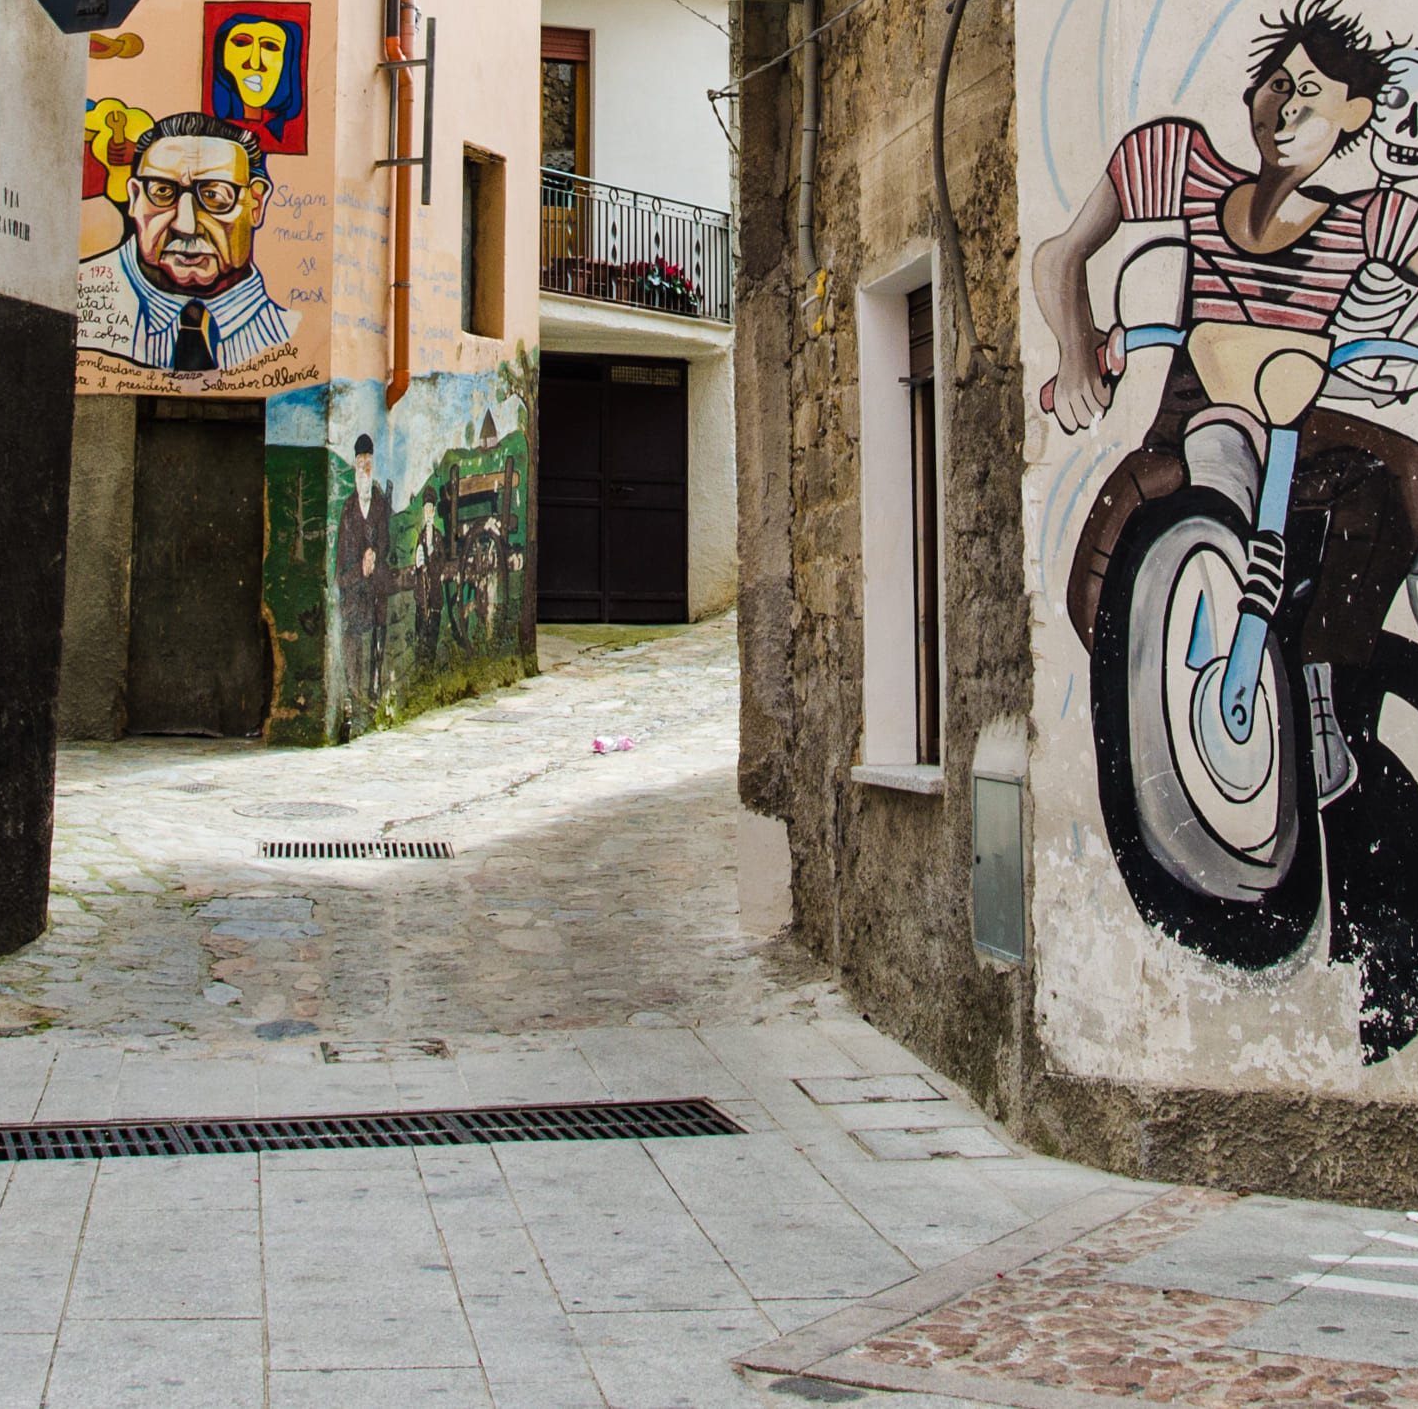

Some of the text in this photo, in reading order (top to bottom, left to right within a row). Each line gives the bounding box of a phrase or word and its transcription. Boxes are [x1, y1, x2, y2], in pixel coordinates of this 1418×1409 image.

[272, 184, 329, 220] Sigan
[273, 219, 326, 243] mucho
[90, 265, 114, 279] 1973
[94, 325, 131, 348] colpo
[115, 378, 183, 394] presidente
[200, 378, 262, 392] Salvador
[262, 363, 320, 388] Allende
